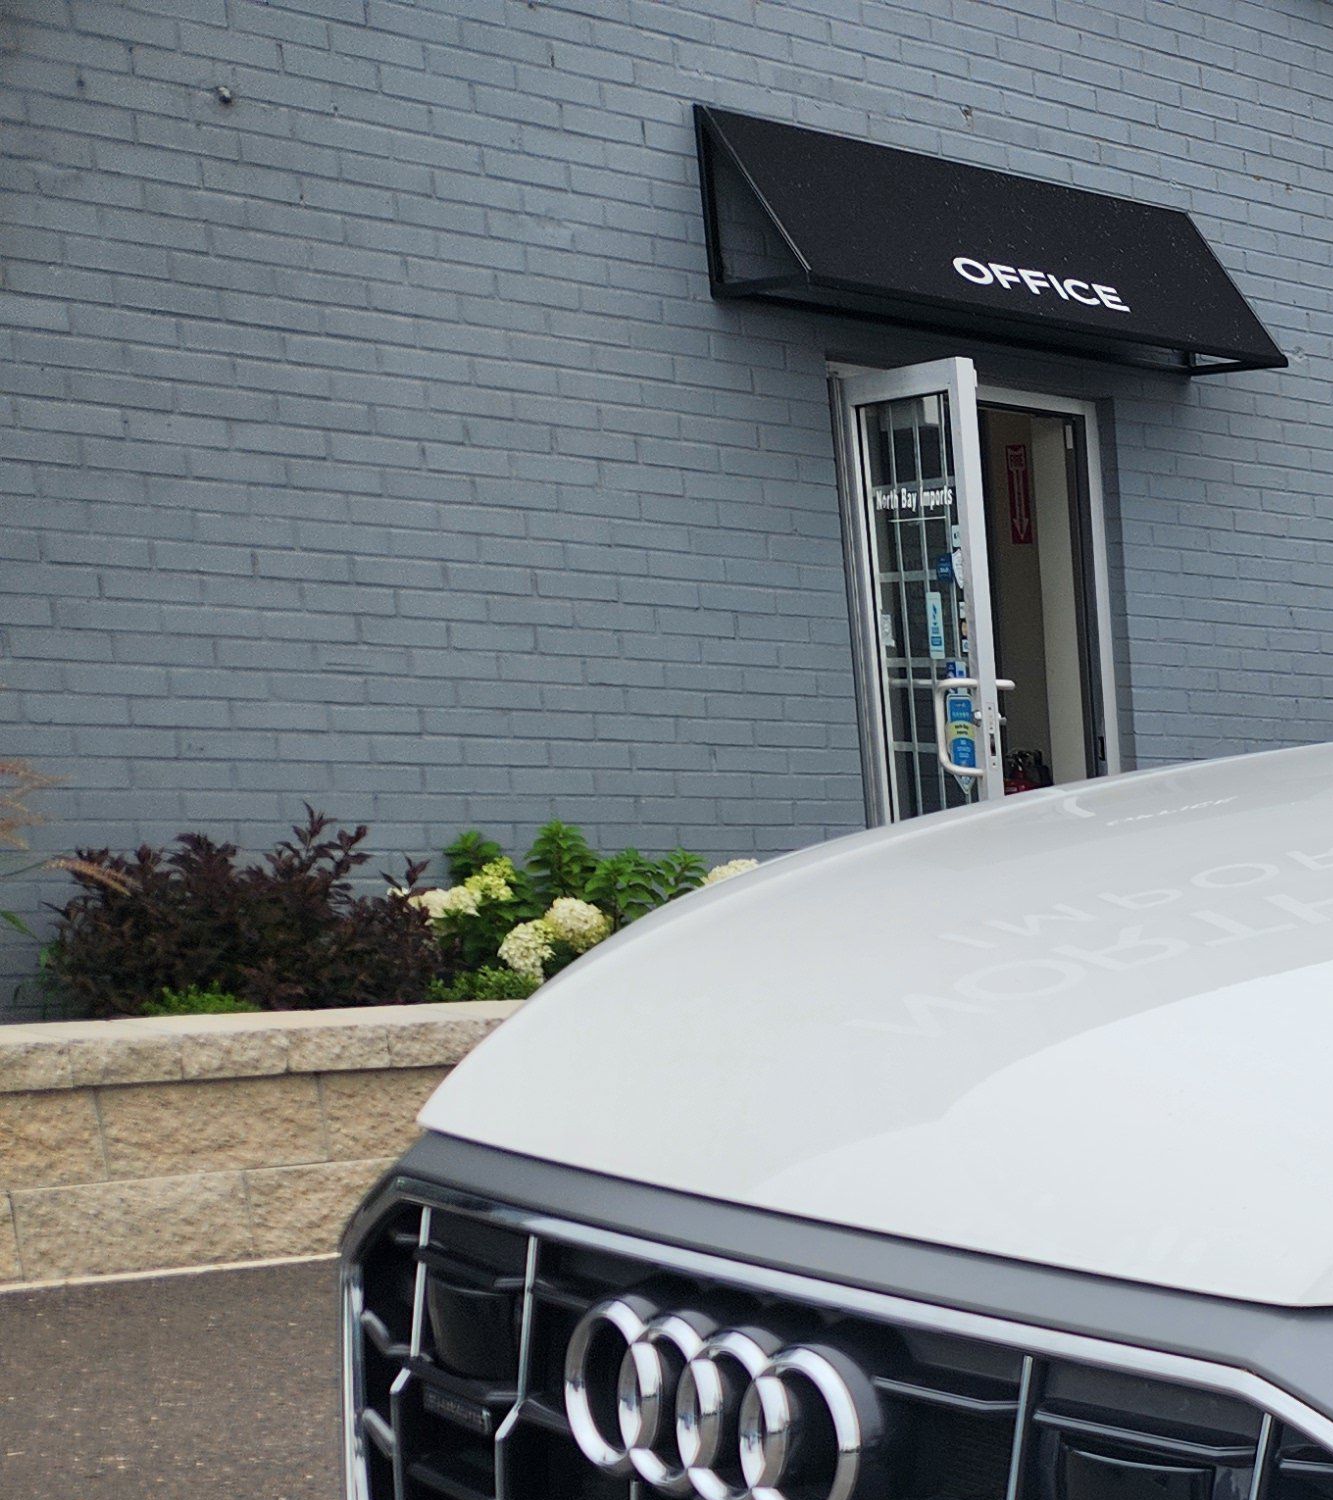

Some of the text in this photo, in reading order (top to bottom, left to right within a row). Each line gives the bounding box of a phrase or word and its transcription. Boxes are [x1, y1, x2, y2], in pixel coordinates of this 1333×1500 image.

[952, 256, 1131, 313] OFFICE
[876, 489, 898, 510] North
[901, 487, 917, 512] Bay
